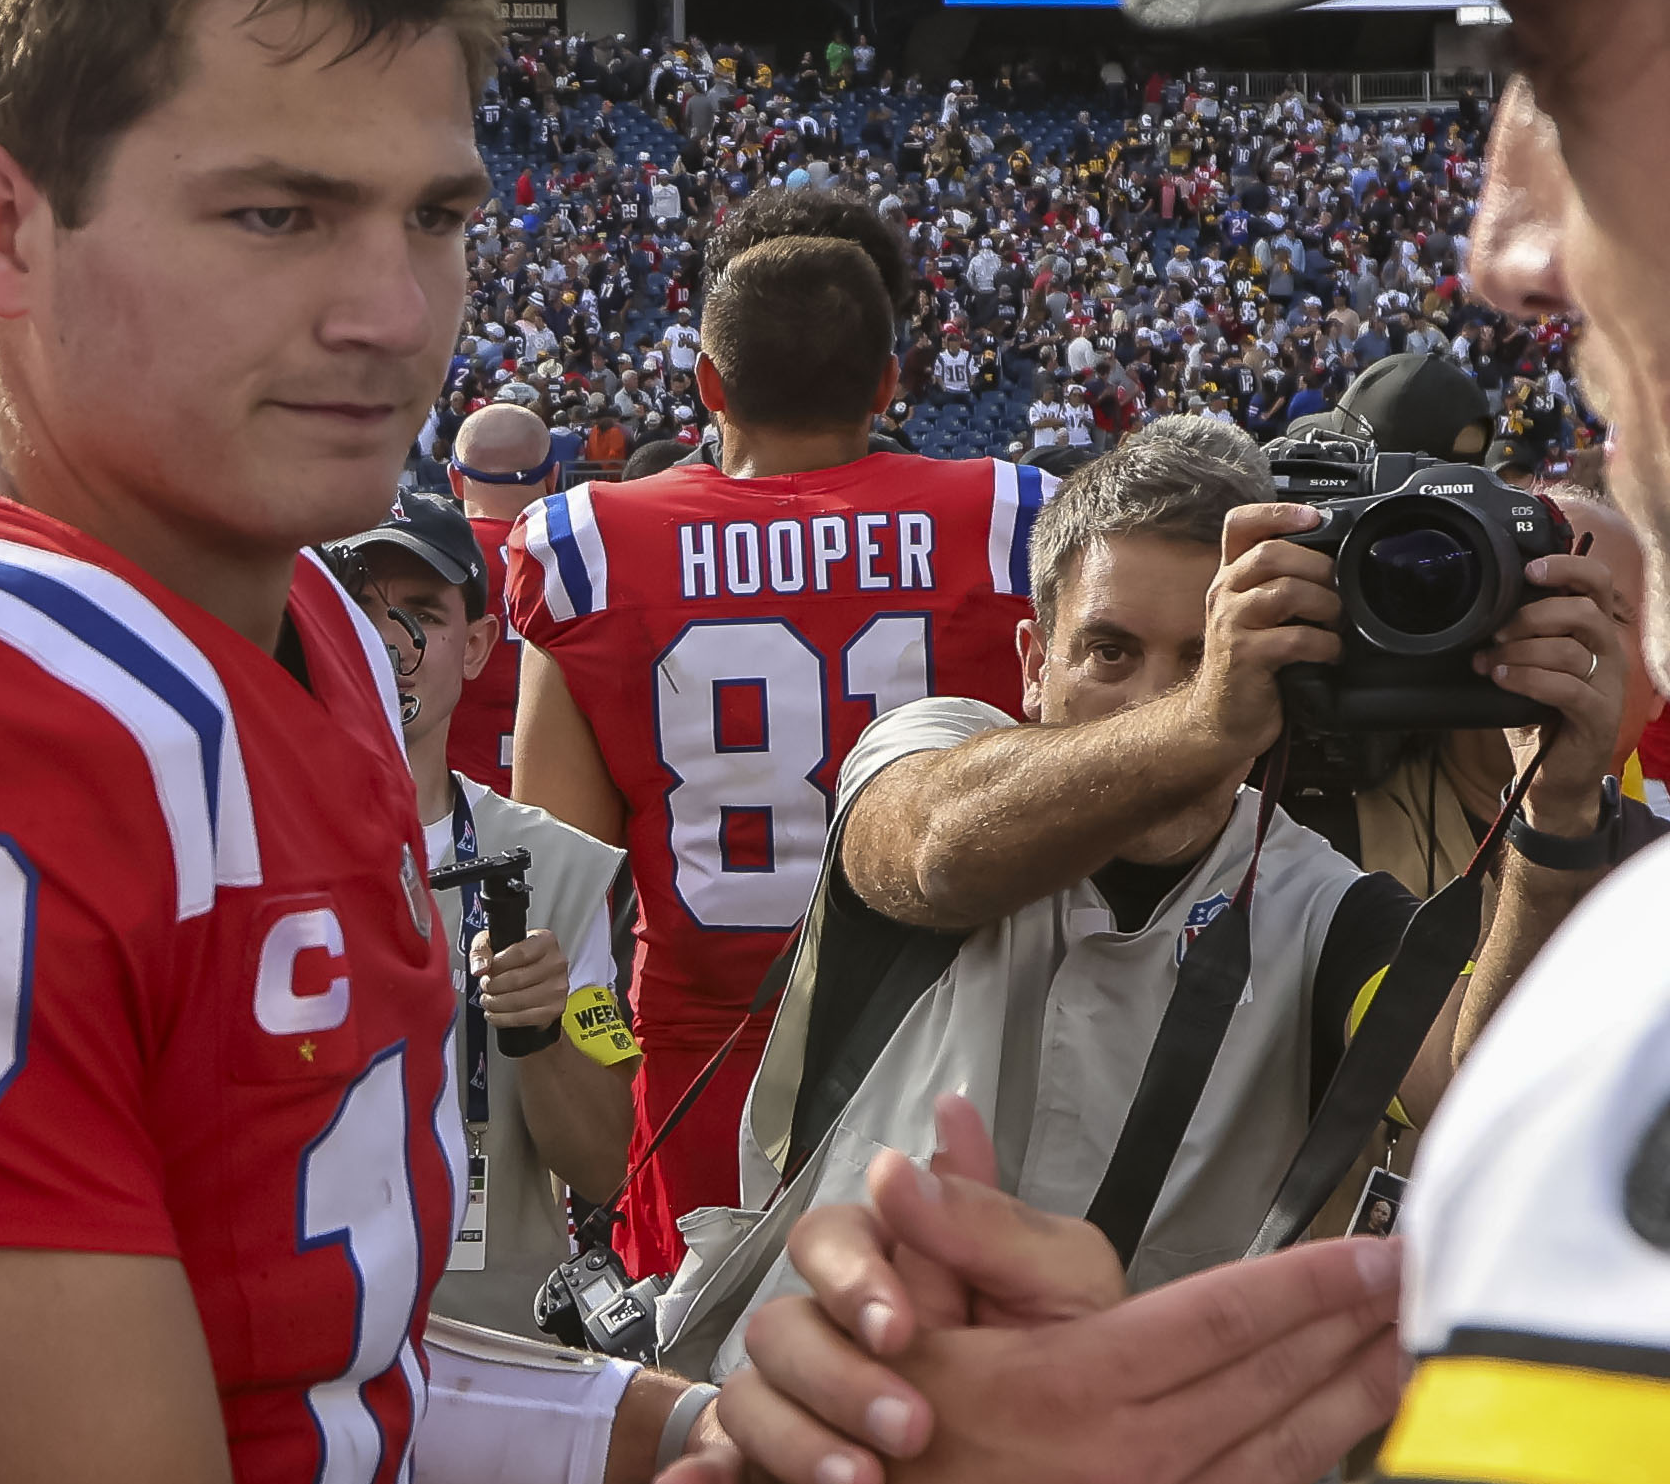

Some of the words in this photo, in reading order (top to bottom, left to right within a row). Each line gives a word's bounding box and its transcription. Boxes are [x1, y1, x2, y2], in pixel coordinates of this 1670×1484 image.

[1310, 478, 1349, 487] SONY
[1419, 482, 1474, 496] Canon
[1512, 506, 1534, 516] EOS
[1516, 521, 1534, 532] R3
[679, 510, 937, 600] HOOPER
[650, 610, 937, 932] 81
[254, 908, 350, 1036] C
